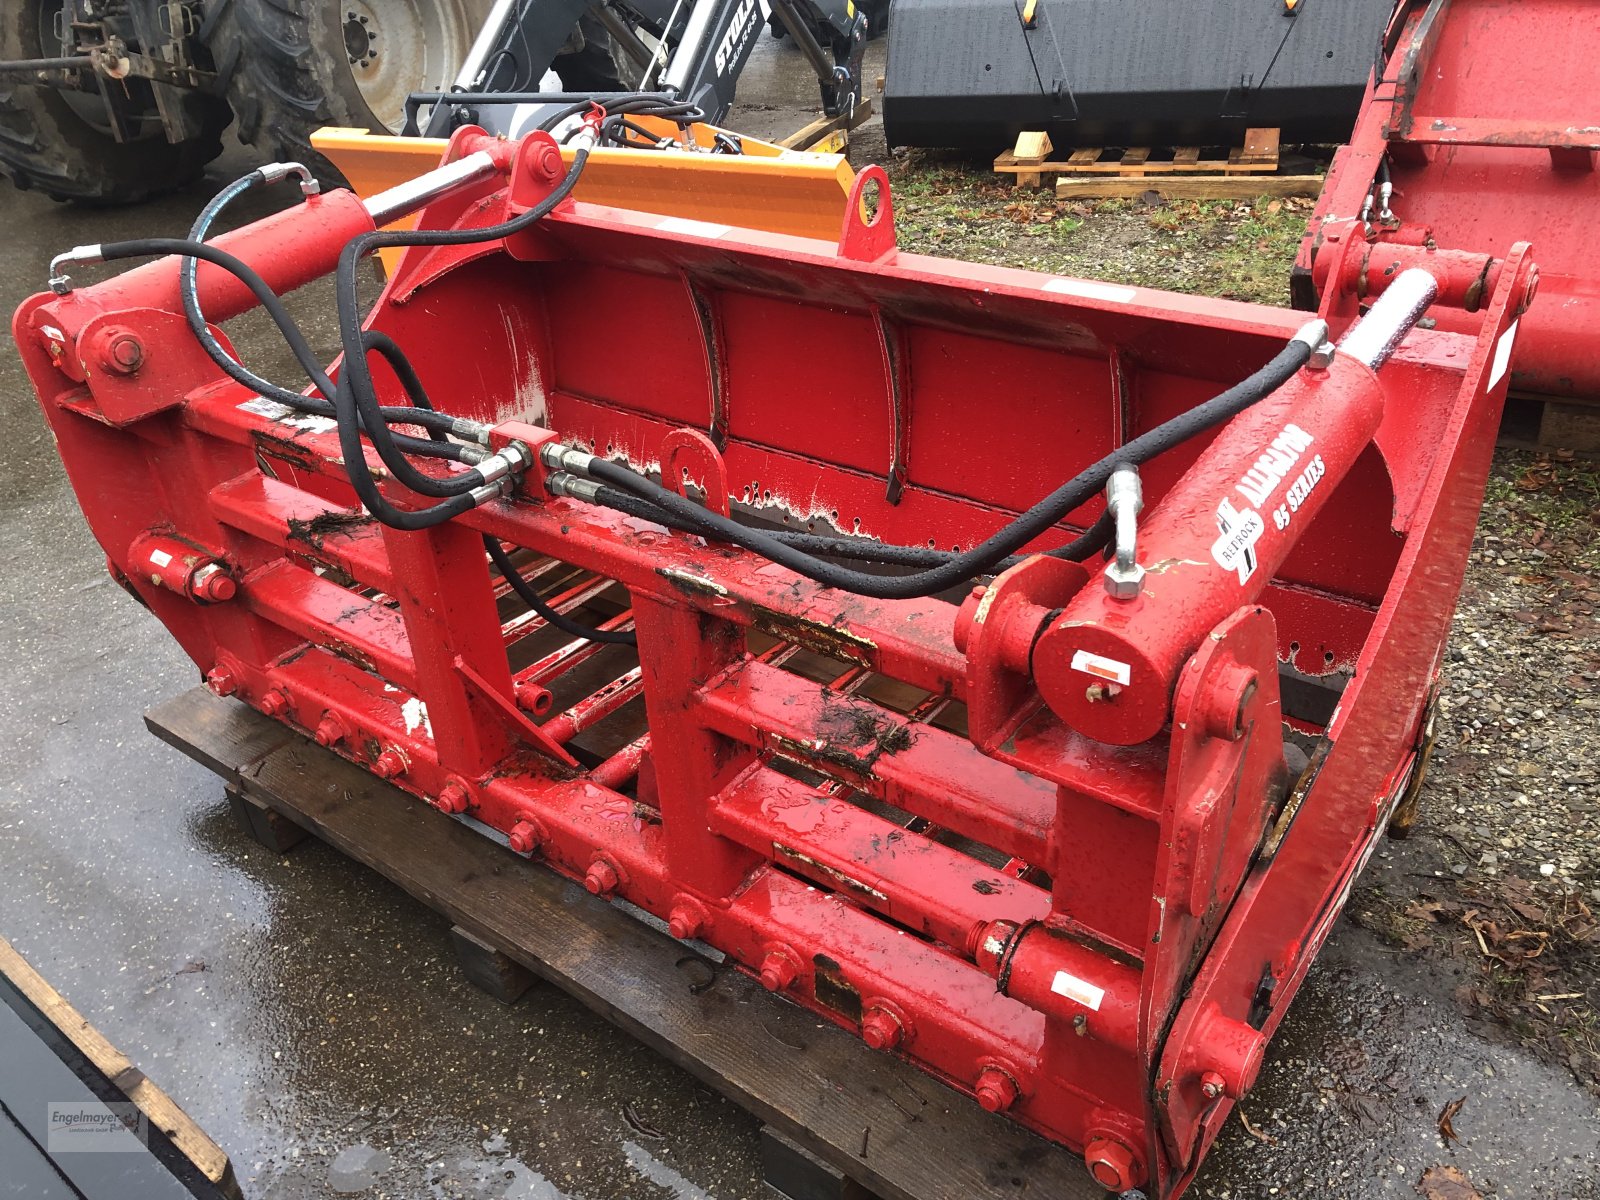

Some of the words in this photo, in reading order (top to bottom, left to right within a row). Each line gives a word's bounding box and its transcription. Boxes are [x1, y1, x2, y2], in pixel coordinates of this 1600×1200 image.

[1272, 503, 1292, 531] 85
[1286, 454, 1326, 513] SERIES
[1221, 518, 1258, 562] REDROCK
